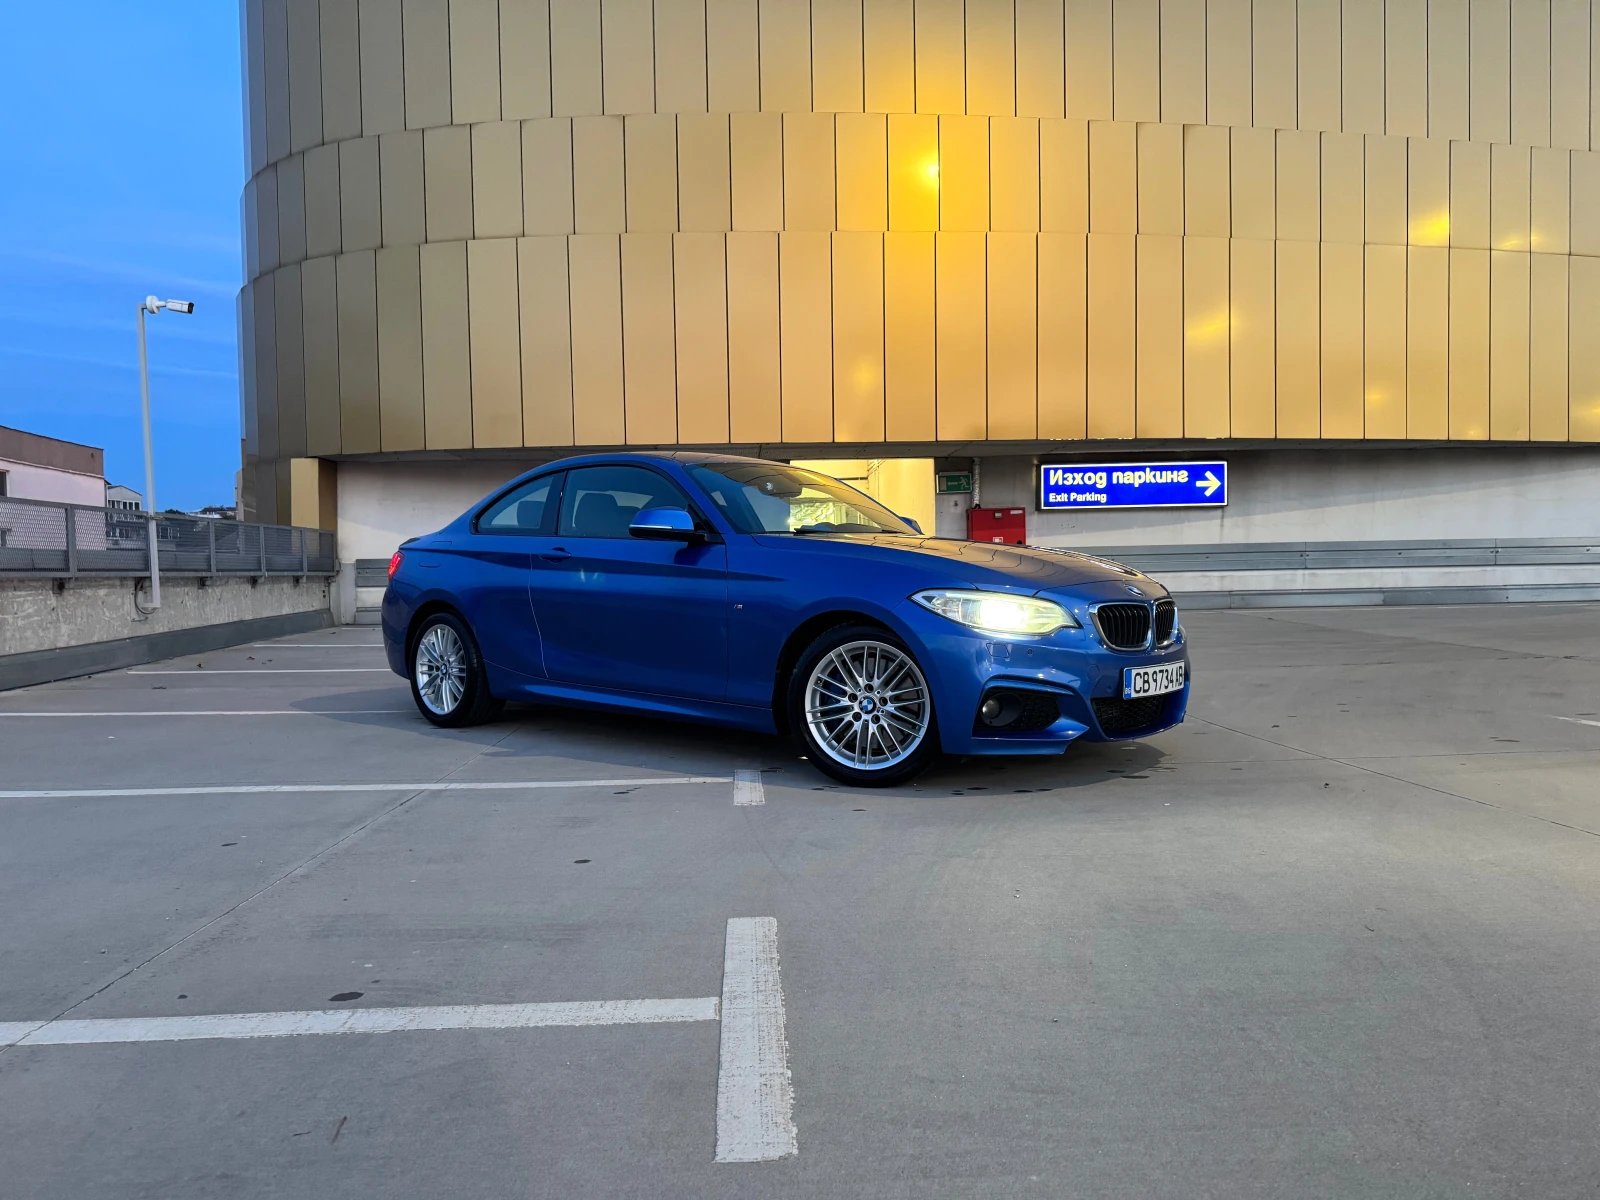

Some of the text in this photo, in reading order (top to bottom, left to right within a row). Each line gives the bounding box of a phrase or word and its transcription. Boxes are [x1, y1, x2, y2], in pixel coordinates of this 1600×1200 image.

[1049, 467, 1189, 489] Изход паркинг
[1049, 492, 1107, 503] Exit Parking
[1134, 672, 1150, 693] CB
[1152, 668, 1174, 691] 9734
